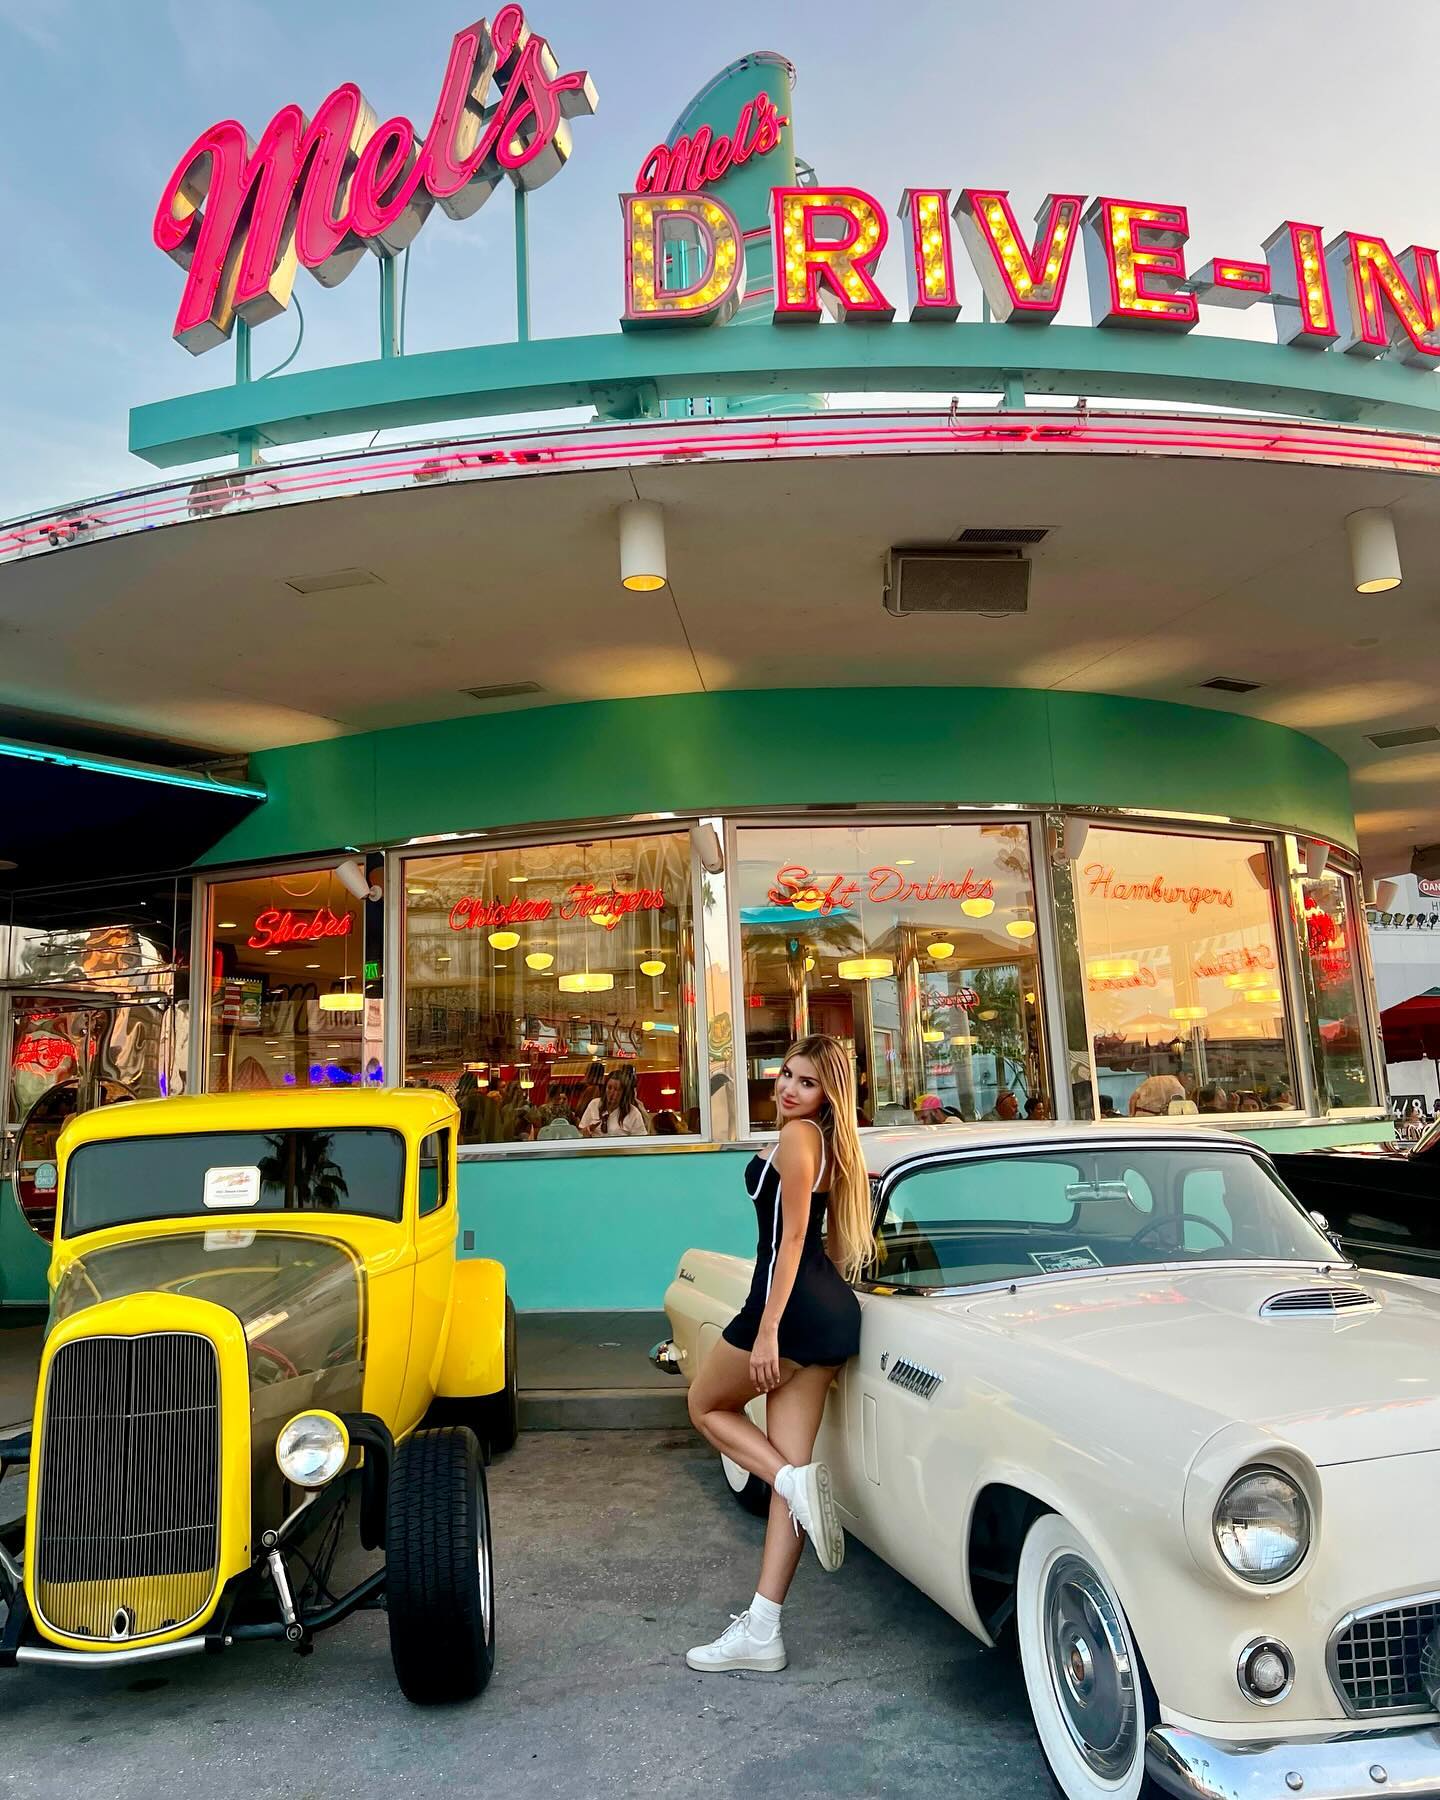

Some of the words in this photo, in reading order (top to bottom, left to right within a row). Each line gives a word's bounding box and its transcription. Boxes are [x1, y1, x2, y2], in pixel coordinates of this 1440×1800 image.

[635, 91, 789, 193] Mel's
[153, 3, 598, 354] Mel's
[622, 187, 1440, 372] DRIVE-IN
[450, 896, 553, 931] Chicken
[560, 882, 664, 931] Fingers
[768, 865, 861, 916] Soft
[868, 865, 994, 902] Drinks
[1084, 864, 1234, 913] Hamburgers
[247, 908, 352, 948] Shakes
